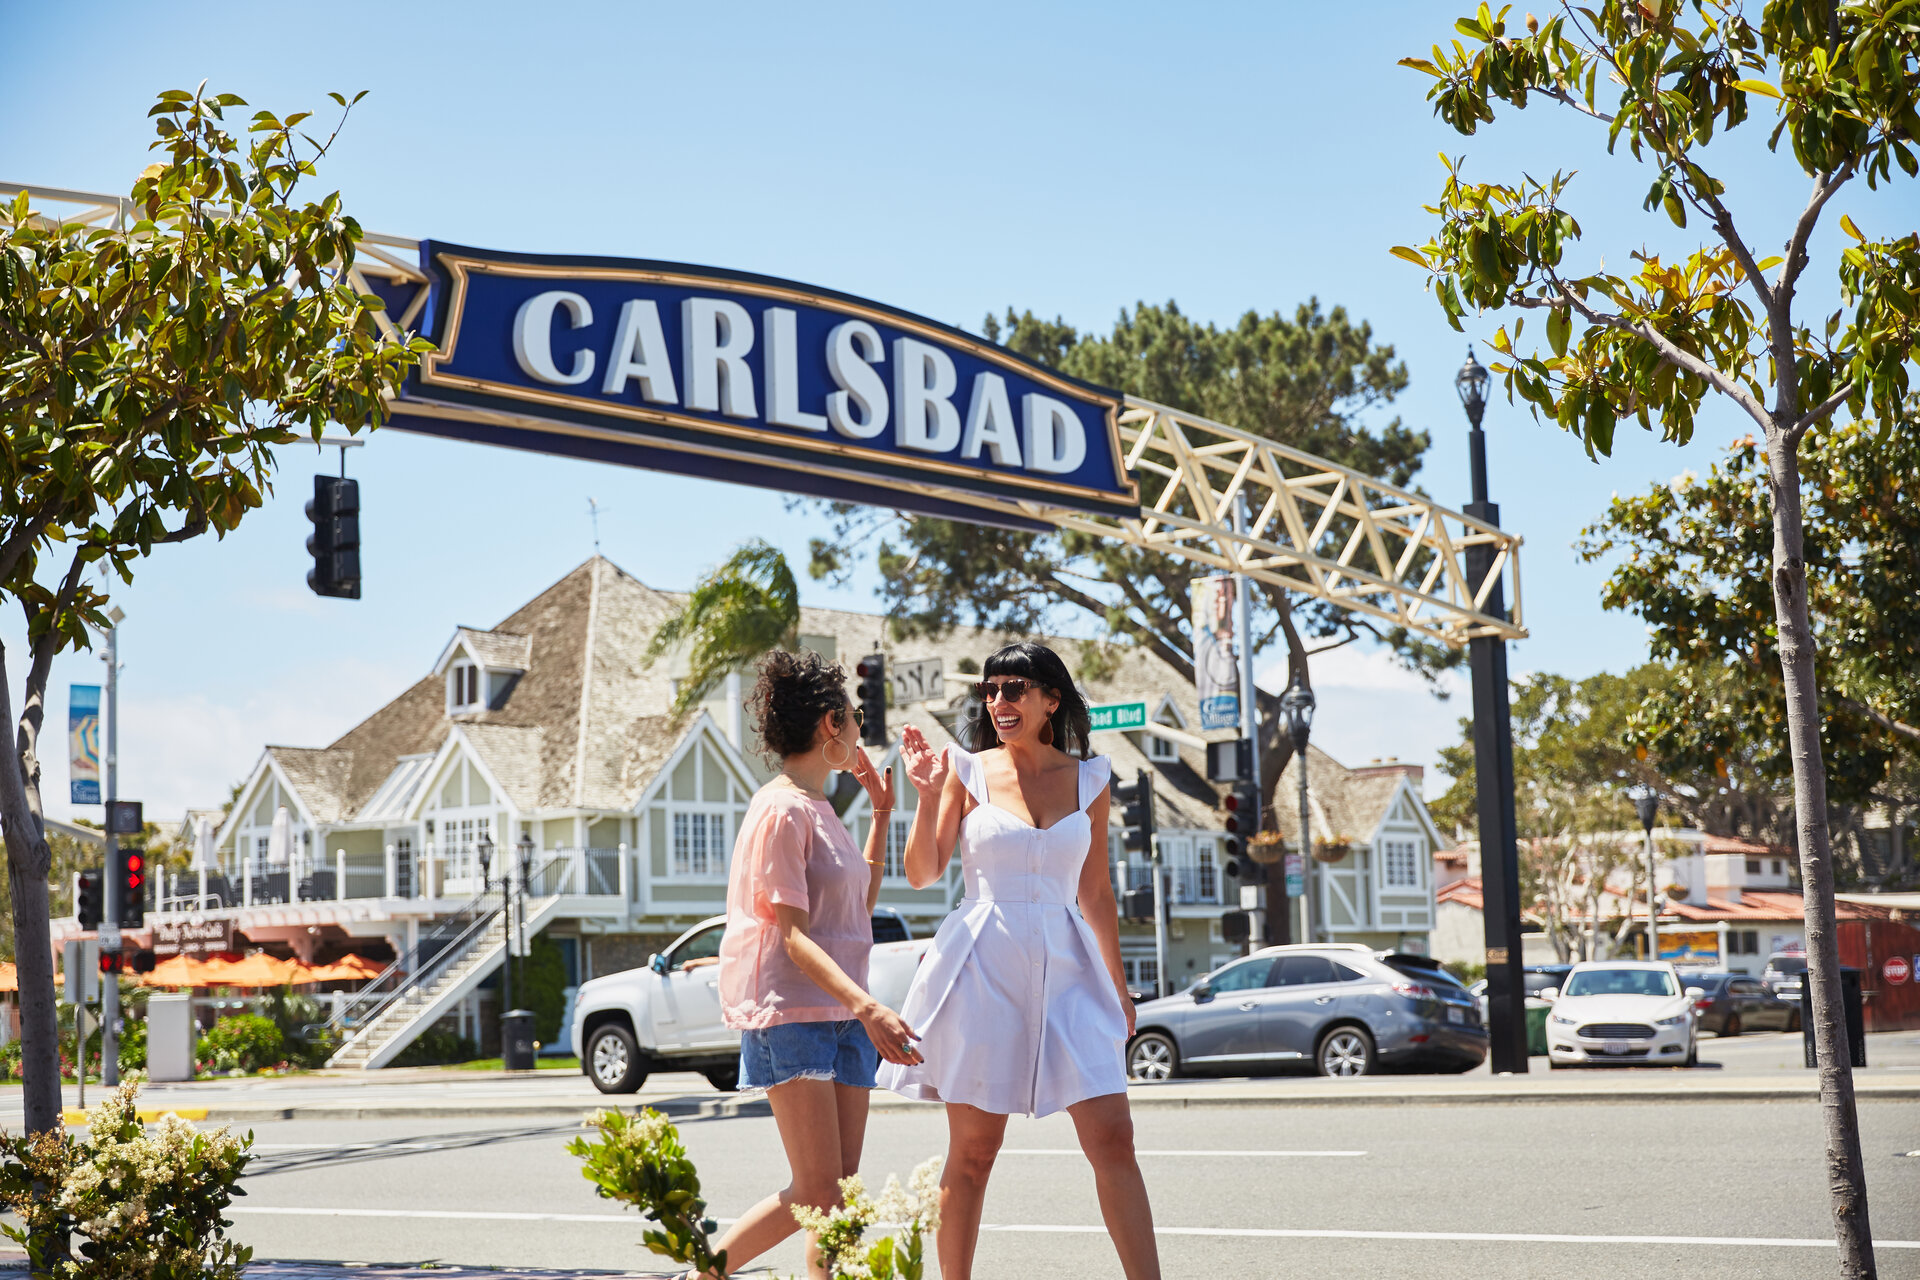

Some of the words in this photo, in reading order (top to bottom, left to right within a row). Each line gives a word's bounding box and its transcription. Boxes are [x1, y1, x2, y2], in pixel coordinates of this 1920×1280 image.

[513, 290, 1087, 475] CARLSBAD
[1117, 708, 1142, 724] Blvd
[1884, 963, 1908, 977] STOP
